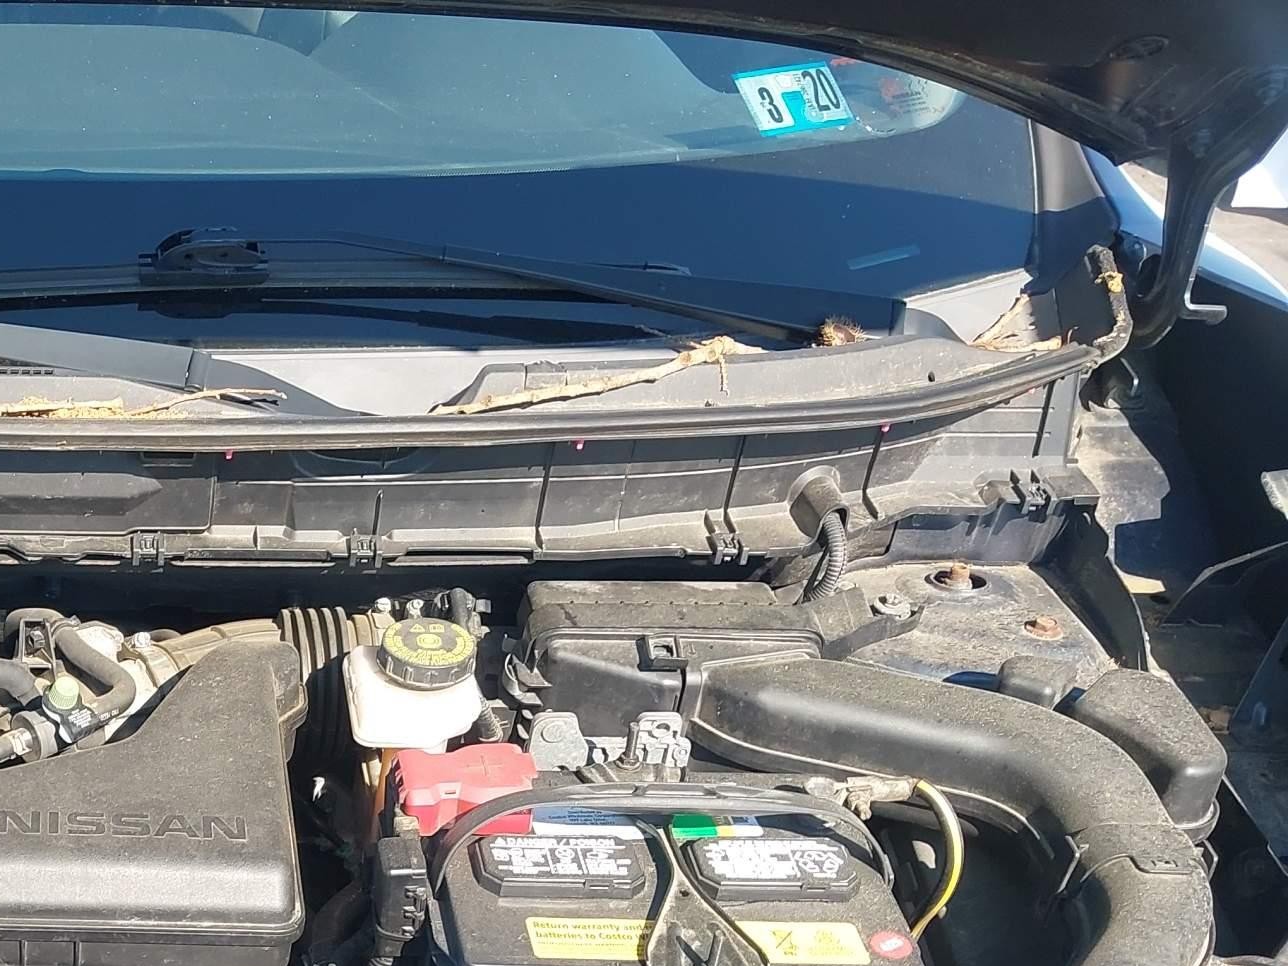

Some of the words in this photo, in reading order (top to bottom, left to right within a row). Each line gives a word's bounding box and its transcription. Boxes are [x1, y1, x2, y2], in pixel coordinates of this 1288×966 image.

[801, 68, 841, 112] 20
[757, 86, 784, 124] 3
[533, 921, 569, 930] Return
[572, 923, 620, 932] warranty
[535, 931, 582, 939] batteries
[585, 932, 596, 940] to
